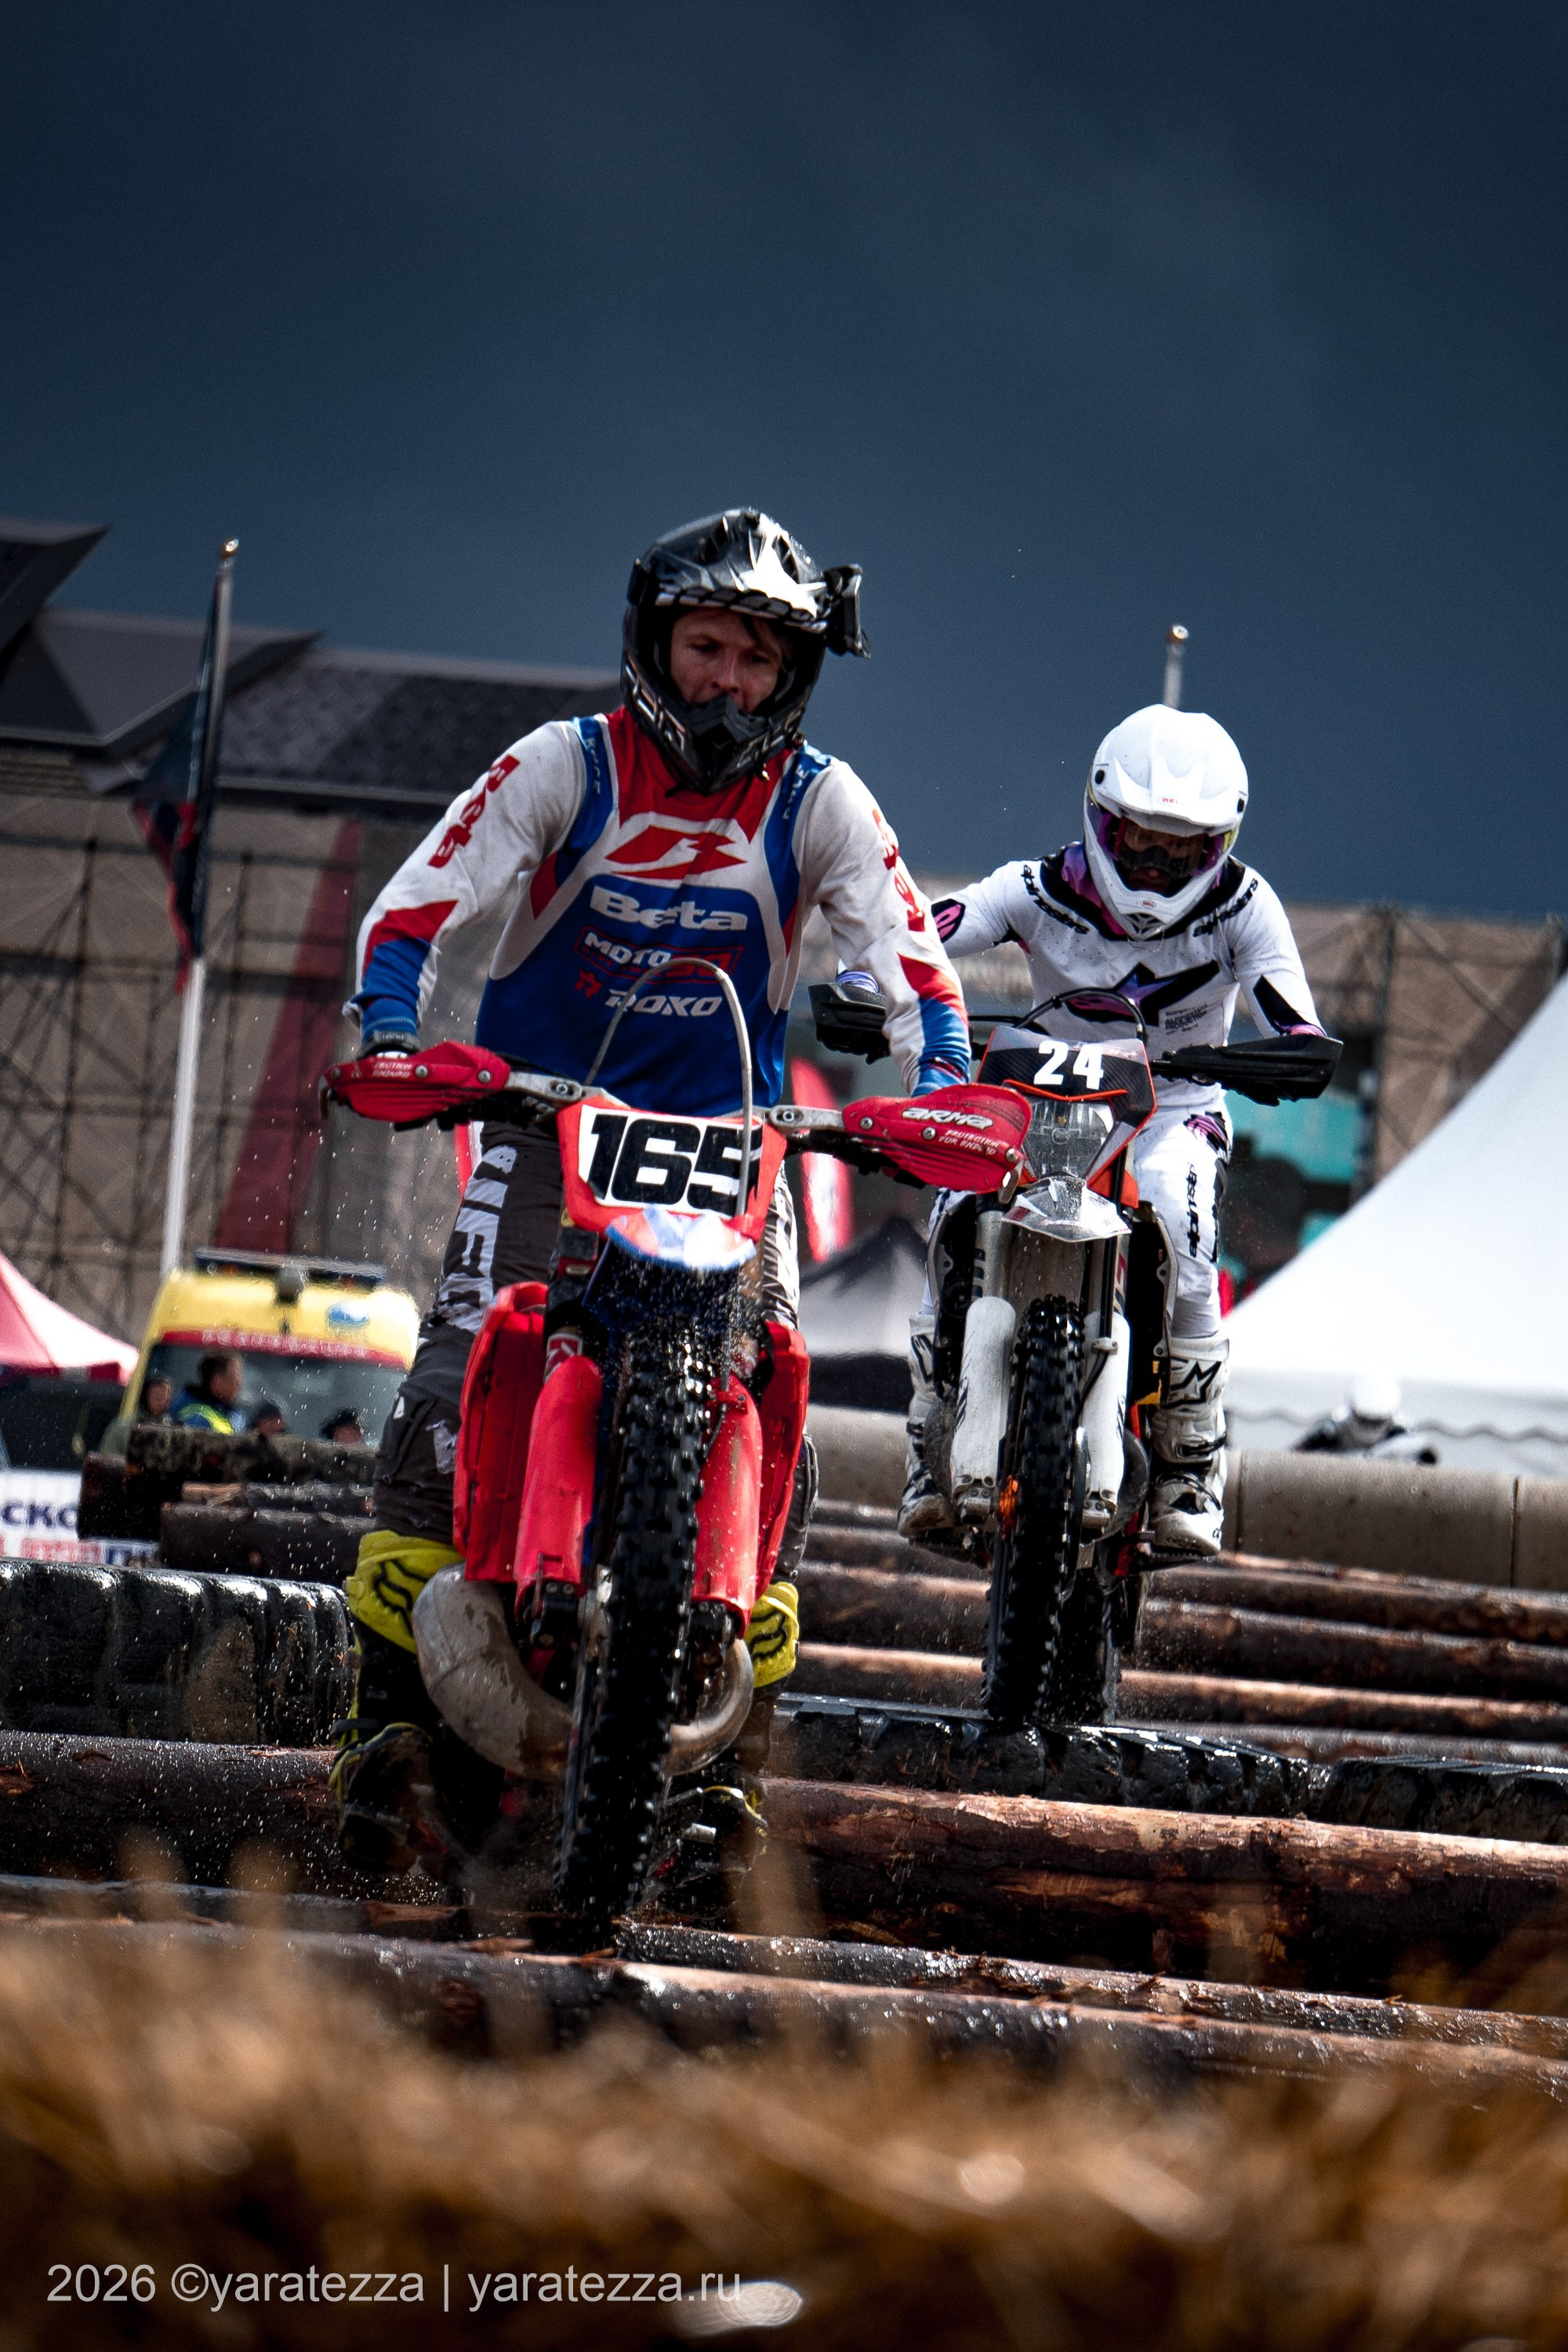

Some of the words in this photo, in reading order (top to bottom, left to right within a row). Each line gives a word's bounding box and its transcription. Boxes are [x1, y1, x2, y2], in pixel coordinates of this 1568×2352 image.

[590, 885, 749, 931] Beta
[584, 931, 672, 967] MOTO
[1033, 1040, 1104, 1091] 24
[938, 1136, 959, 1145] FOR
[587, 1113, 764, 1219] 165
